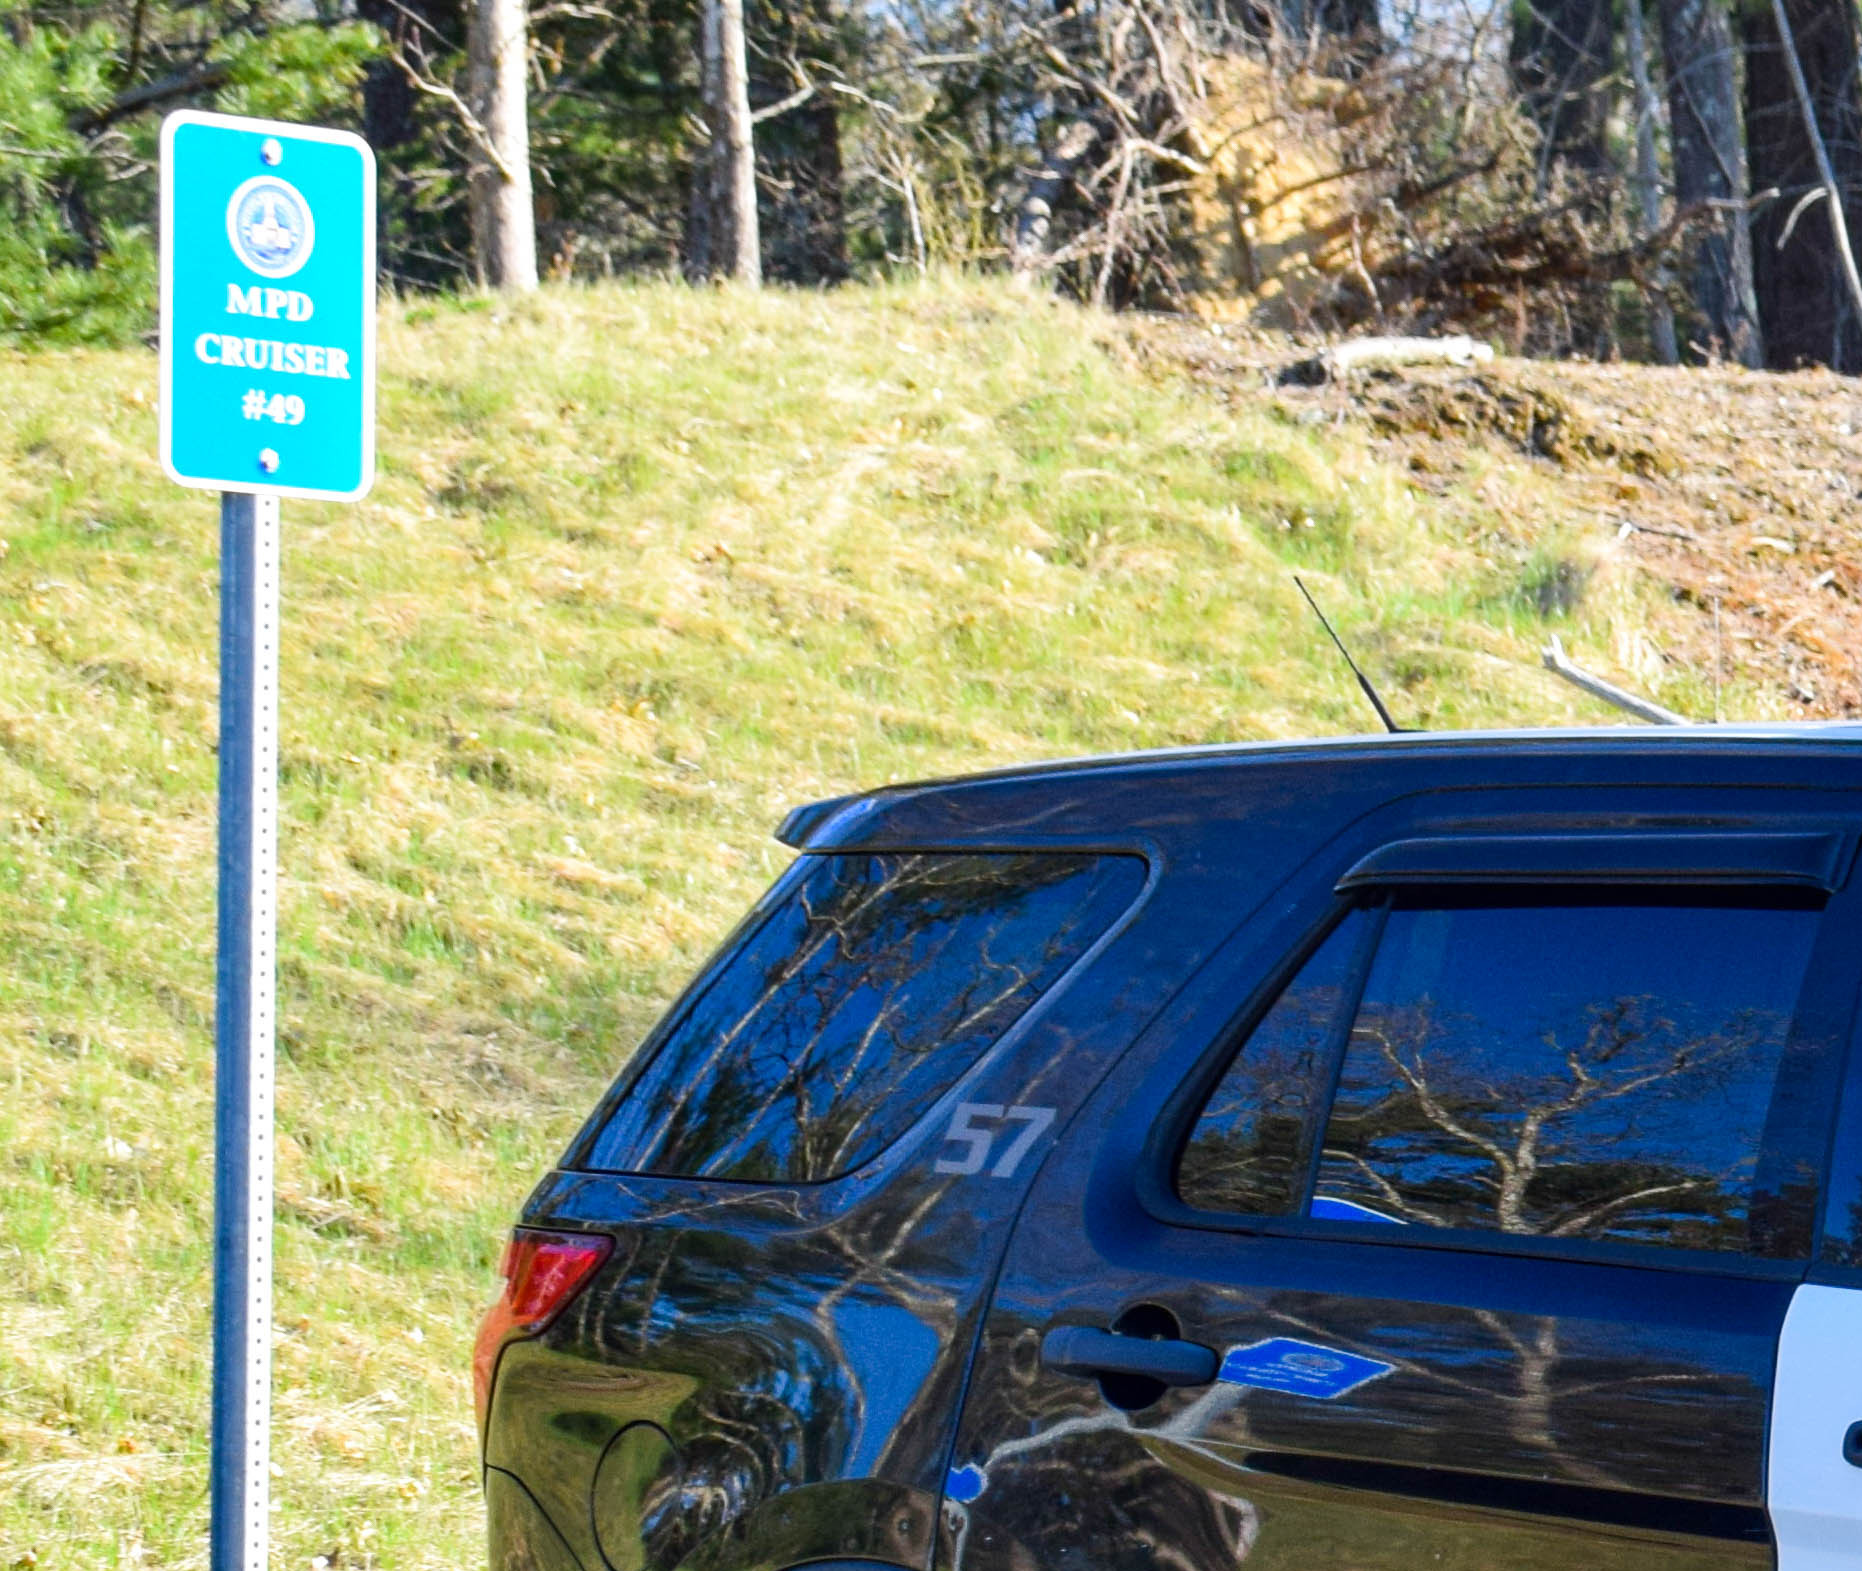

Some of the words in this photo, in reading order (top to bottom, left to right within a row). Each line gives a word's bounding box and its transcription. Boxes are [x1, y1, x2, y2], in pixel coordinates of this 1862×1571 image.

[226, 283, 314, 323] MPD
[194, 333, 351, 380] CRUISER
[242, 388, 306, 426] #49
[934, 1102, 1057, 1178] 57
